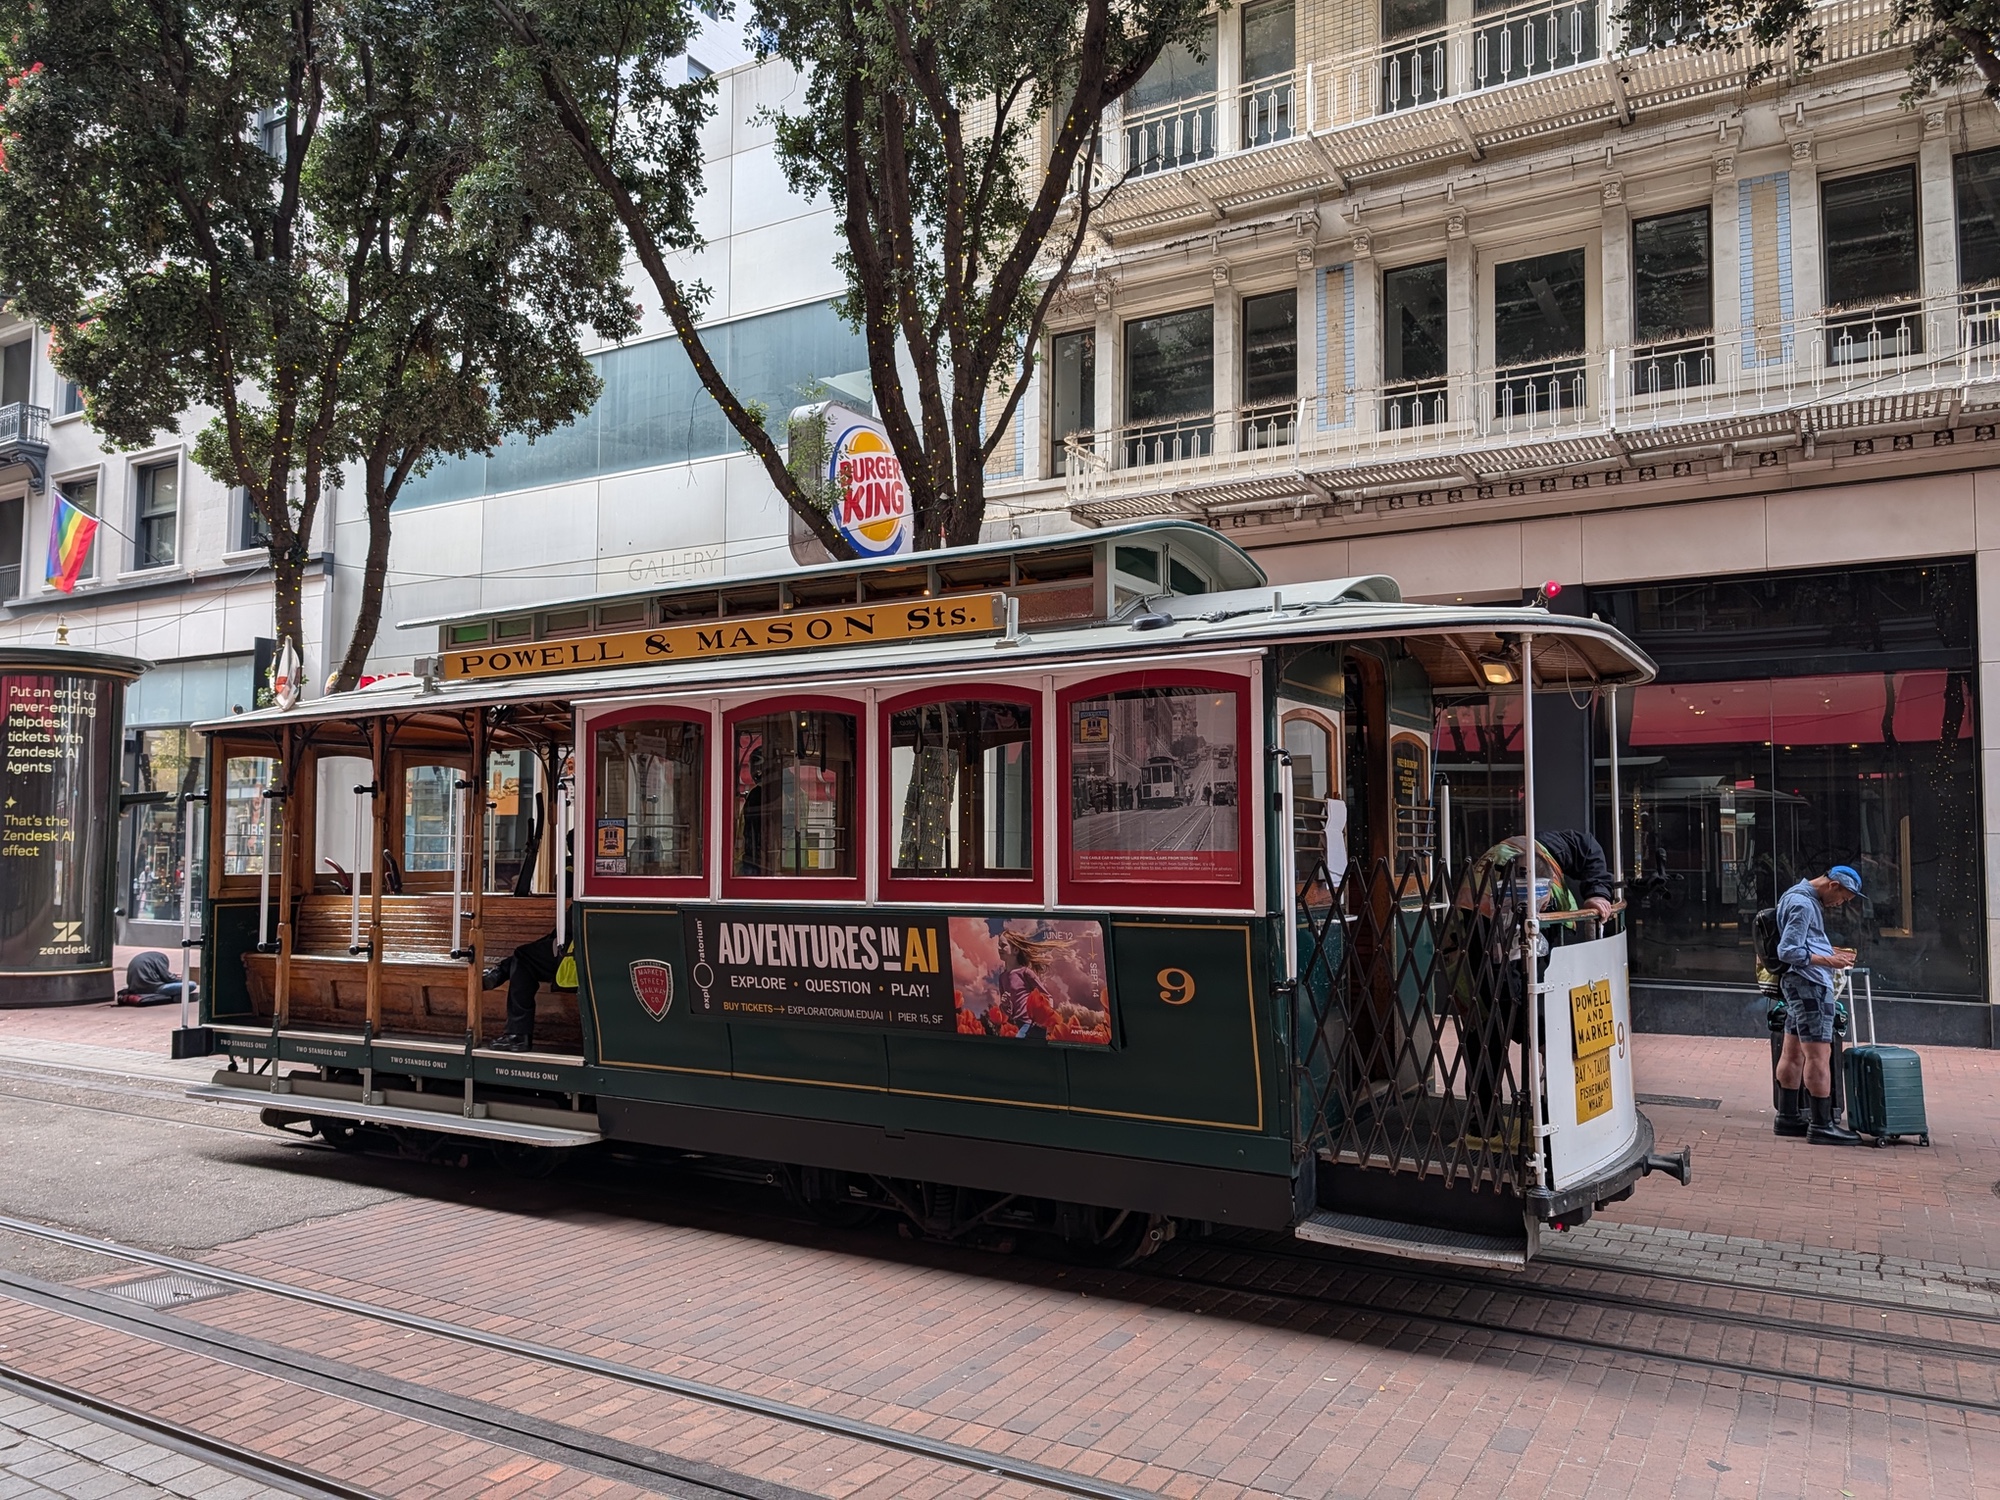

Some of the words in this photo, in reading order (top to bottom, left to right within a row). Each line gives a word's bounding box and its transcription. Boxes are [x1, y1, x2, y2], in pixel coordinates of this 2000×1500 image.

[840, 456, 901, 488] BURGER
[843, 481, 904, 525] KING
[628, 549, 718, 581] GALLERY
[460, 641, 624, 674] POWELL
[645, 633, 674, 655] &
[697, 614, 876, 650] MASON
[907, 606, 976, 630] Sts.
[10, 686, 31, 697] Put
[33, 688, 50, 697] an
[54, 688, 80, 699] end
[83, 690, 96, 701] to
[9, 702, 96, 718] never-ending
[8, 715, 69, 729] helpdesk
[8, 730, 51, 743] tickets
[53, 732, 83, 744] with
[7, 745, 63, 758] Zendesk
[65, 747, 78, 759] AI
[6, 761, 52, 775] Agents
[45, 815, 69, 827] the
[3, 830, 59, 842] Zendesk
[61, 831, 75, 842] AI
[2, 844, 40, 856] effect
[1042, 931, 1063, 940] JUNE
[1065, 932, 1073, 940] 12
[39, 944, 91, 955] zendesk
[718, 922, 879, 971] ADVENTURES
[880, 927, 900, 956] IN
[904, 927, 939, 973] AI
[638, 968, 663, 977] MARKET
[1089, 962, 1099, 986] SEPT
[640, 978, 664, 986] STREET
[731, 975, 787, 990] EXPLORE
[805, 978, 871, 995] QUESTION
[891, 983, 930, 998] PLAY!
[1156, 967, 1195, 1005] 9
[1092, 988, 1100, 998] 14
[1575, 989, 1610, 1012] POWELL
[723, 1001, 739, 1011] BUY
[740, 1002, 773, 1014] TICKETS
[787, 1005, 884, 1021] EXPLORATORIUM.EDU/AI
[898, 1012, 917, 1023] PIER
[919, 1013, 931, 1025] 15,
[932, 1014, 943, 1024] SF
[1587, 1008, 1603, 1023] AND
[1578, 1020, 1613, 1045] MARKET
[1617, 1021, 1625, 1059] 9
[232, 1039, 254, 1048] STANDEES
[308, 1046, 333, 1056] STANDEES
[390, 1056, 403, 1064] TWO
[404, 1057, 431, 1067] STANDEES
[432, 1061, 447, 1069] ONLY
[495, 1067, 509, 1075] TWO
[511, 1069, 540, 1079] STANDEES
[542, 1073, 558, 1081] ONLY
[1575, 1063, 1586, 1084] BAY
[1588, 1094, 1603, 1112] WHARF
